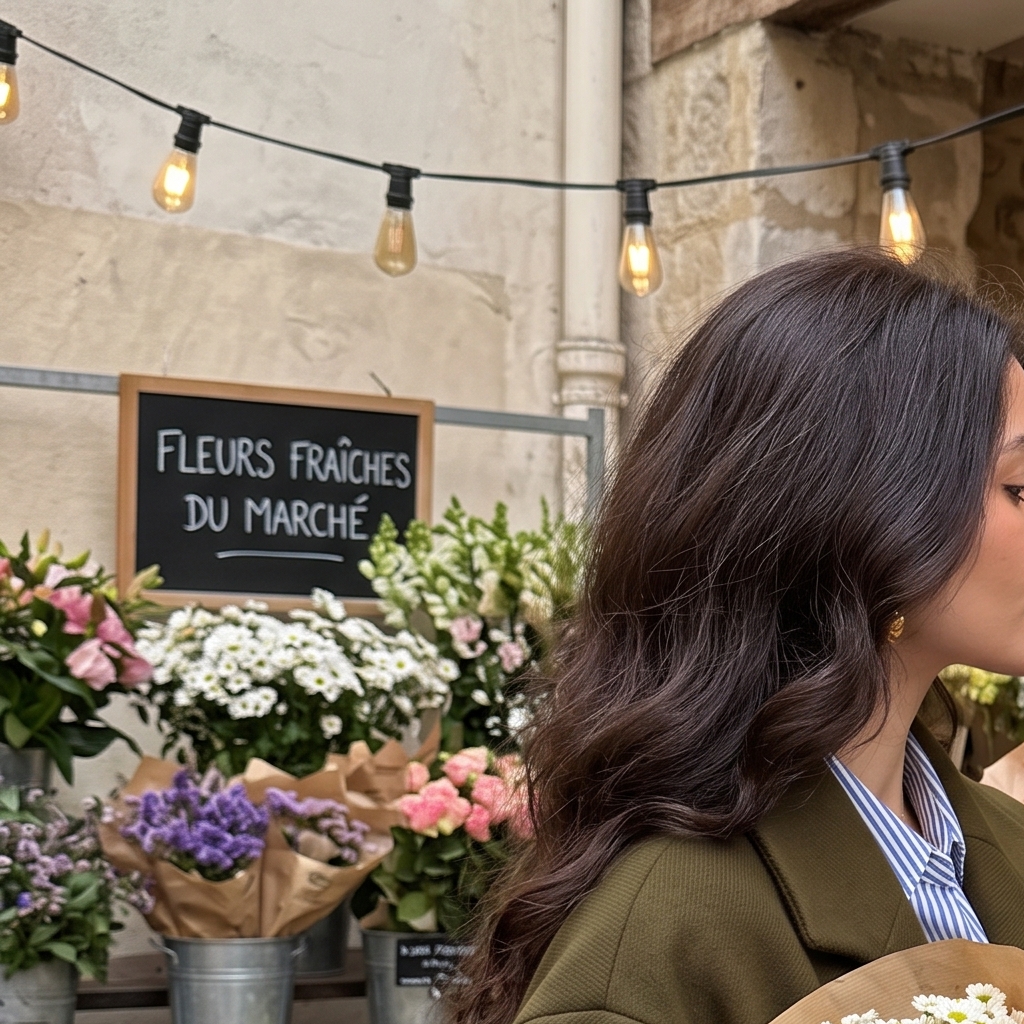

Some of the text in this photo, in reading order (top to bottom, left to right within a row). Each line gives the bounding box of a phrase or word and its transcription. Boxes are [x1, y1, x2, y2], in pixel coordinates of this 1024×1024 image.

[157, 429, 412, 489] FLEURS FRAÎCHES
[183, 493, 370, 541] DU MARCHÉ
